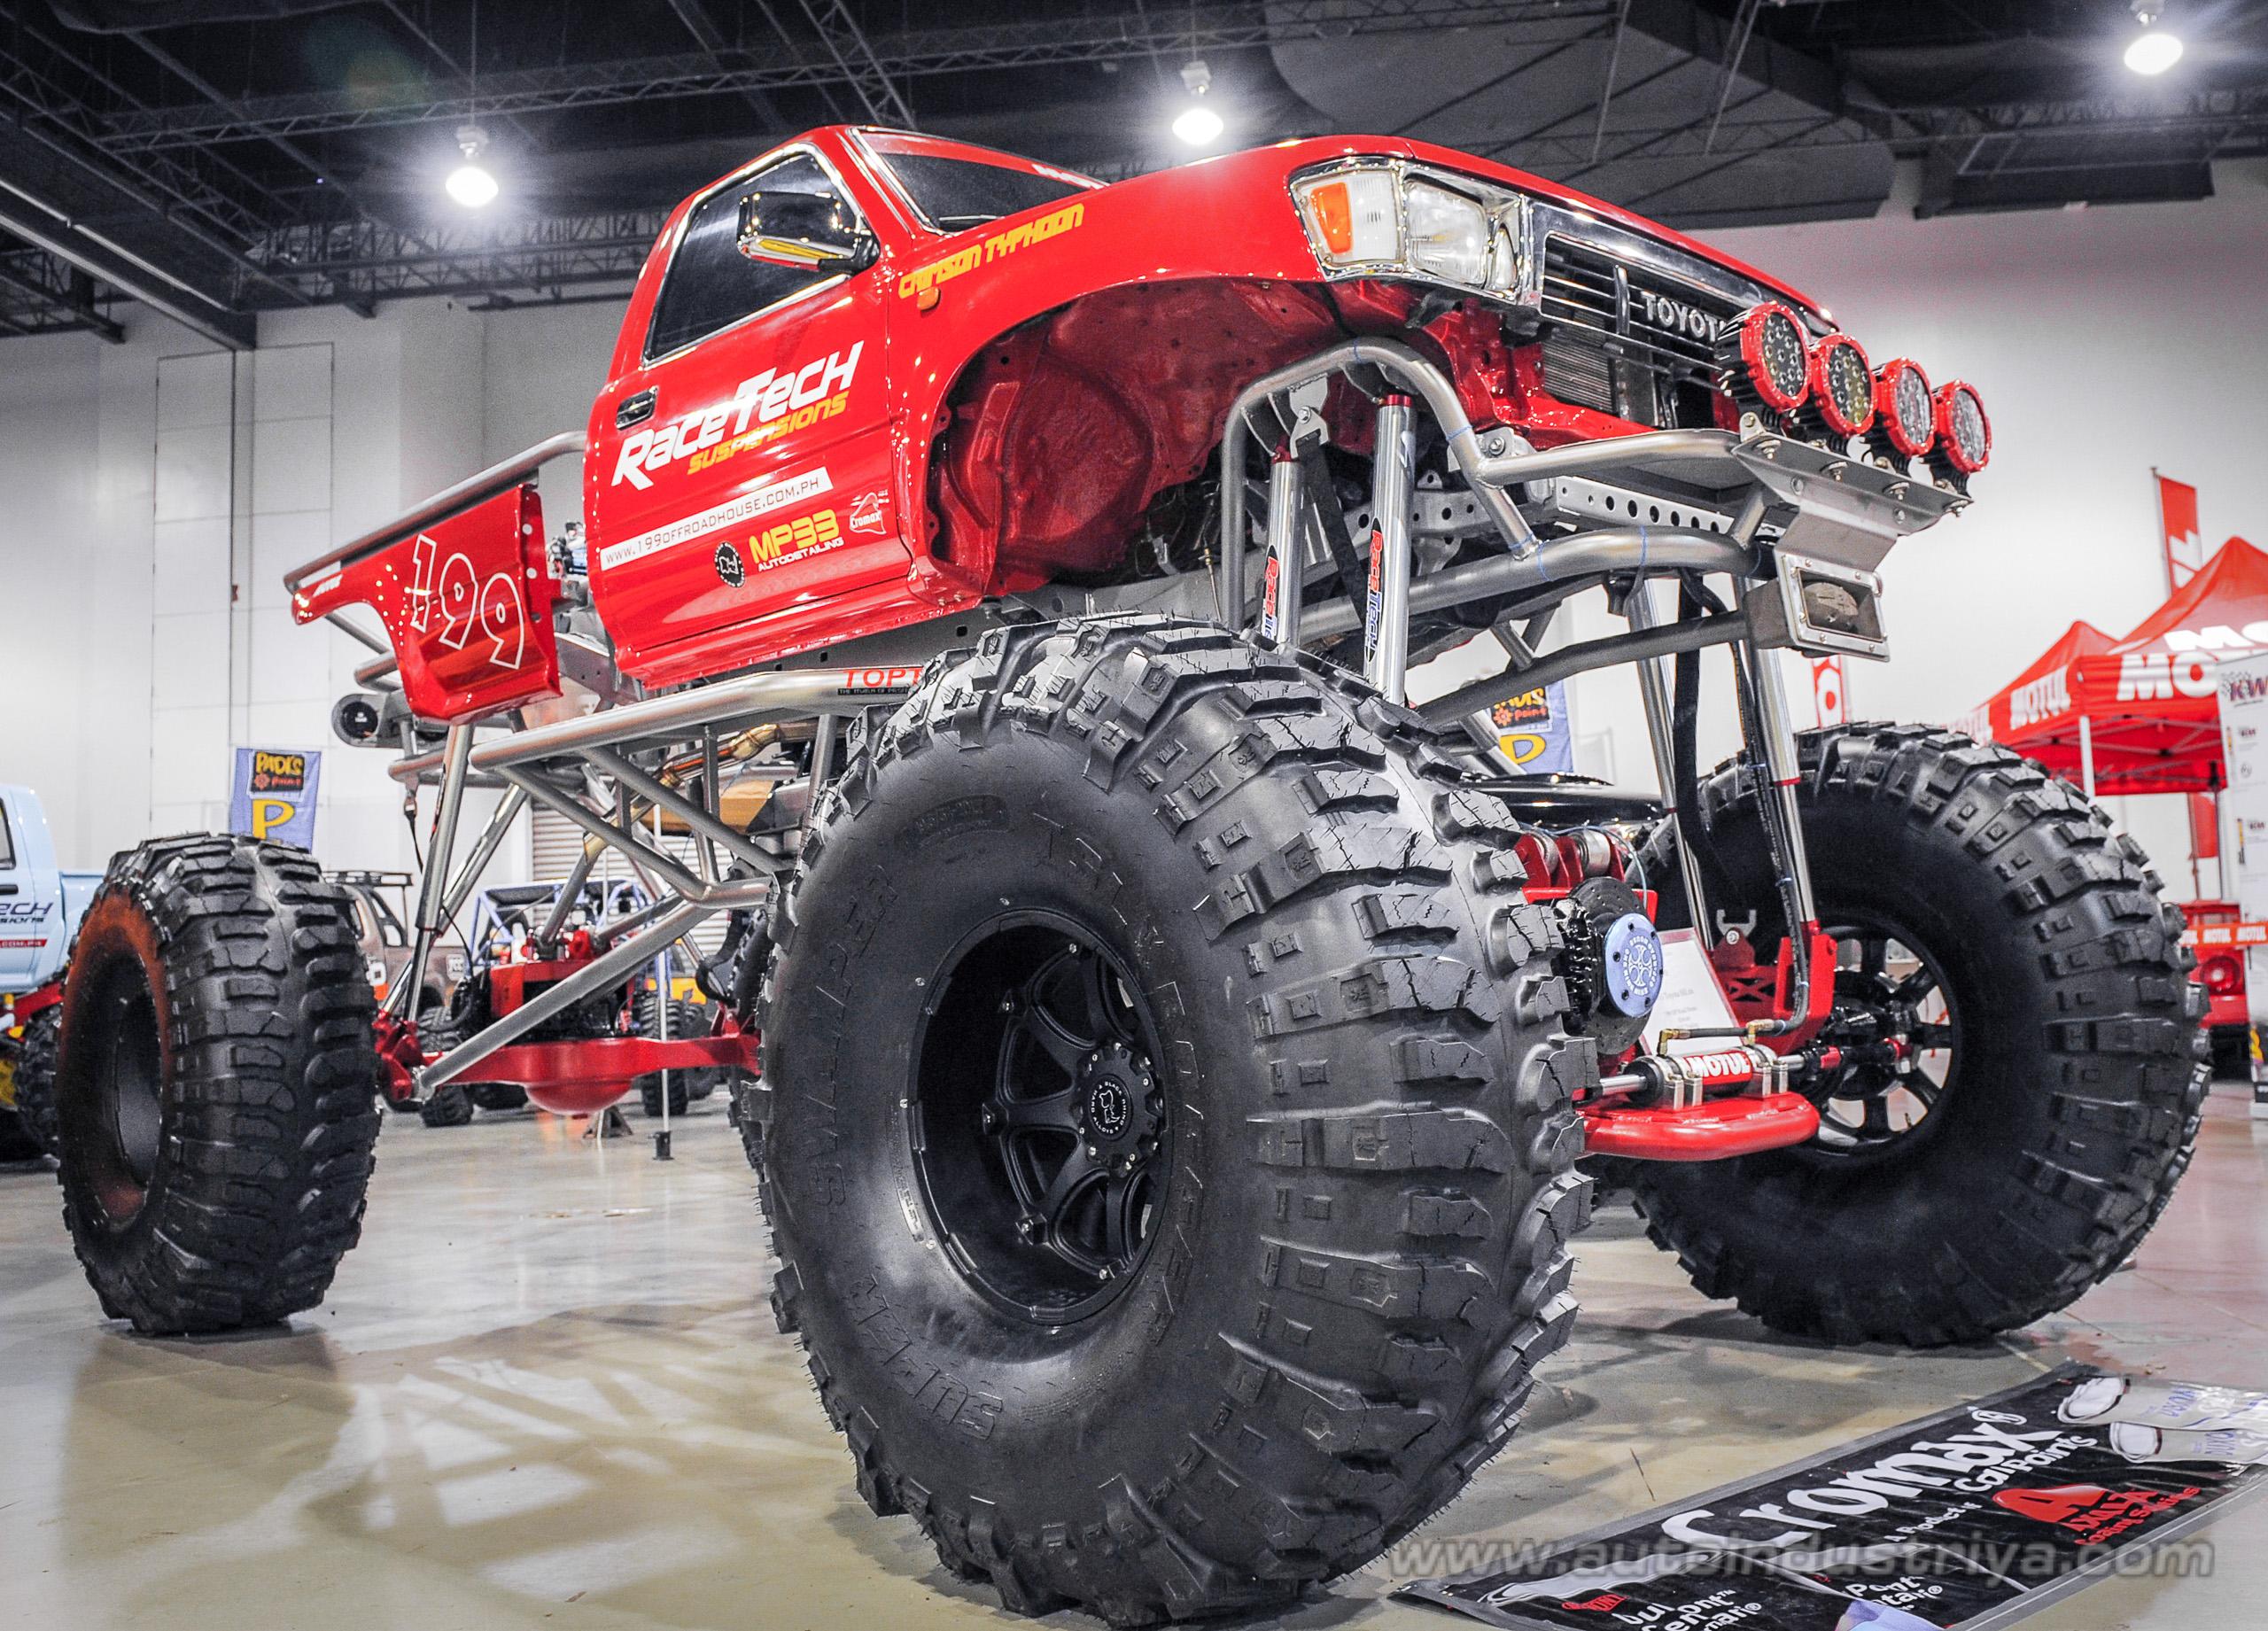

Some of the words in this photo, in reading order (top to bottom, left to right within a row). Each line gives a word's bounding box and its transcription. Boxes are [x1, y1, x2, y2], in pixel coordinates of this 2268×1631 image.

[984, 202, 1084, 263] TYPHOON
[749, 509, 840, 564] MP33
[757, 536, 845, 572] AUTODETAILING
[410, 533, 524, 670] 199
[1685, 1052, 1751, 1077] MOTUL
